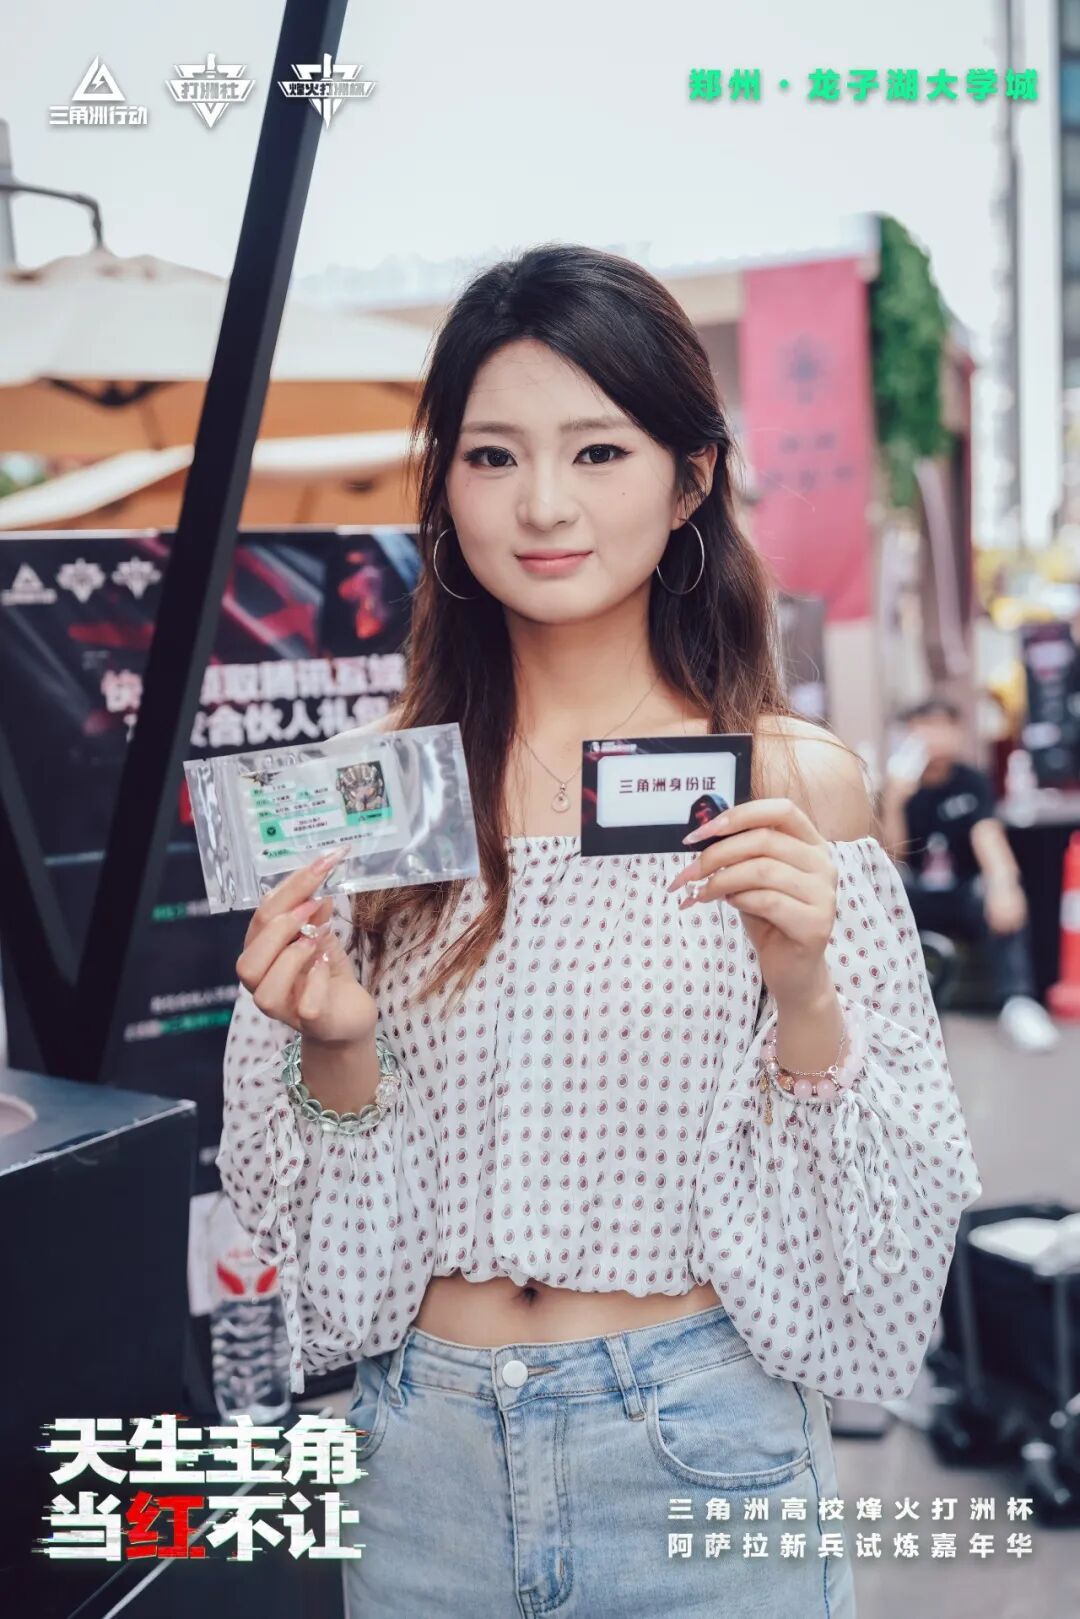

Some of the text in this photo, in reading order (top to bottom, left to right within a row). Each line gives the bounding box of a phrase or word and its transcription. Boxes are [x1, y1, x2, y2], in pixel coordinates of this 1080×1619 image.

[619, 776, 716, 794] 三角洲身份证
